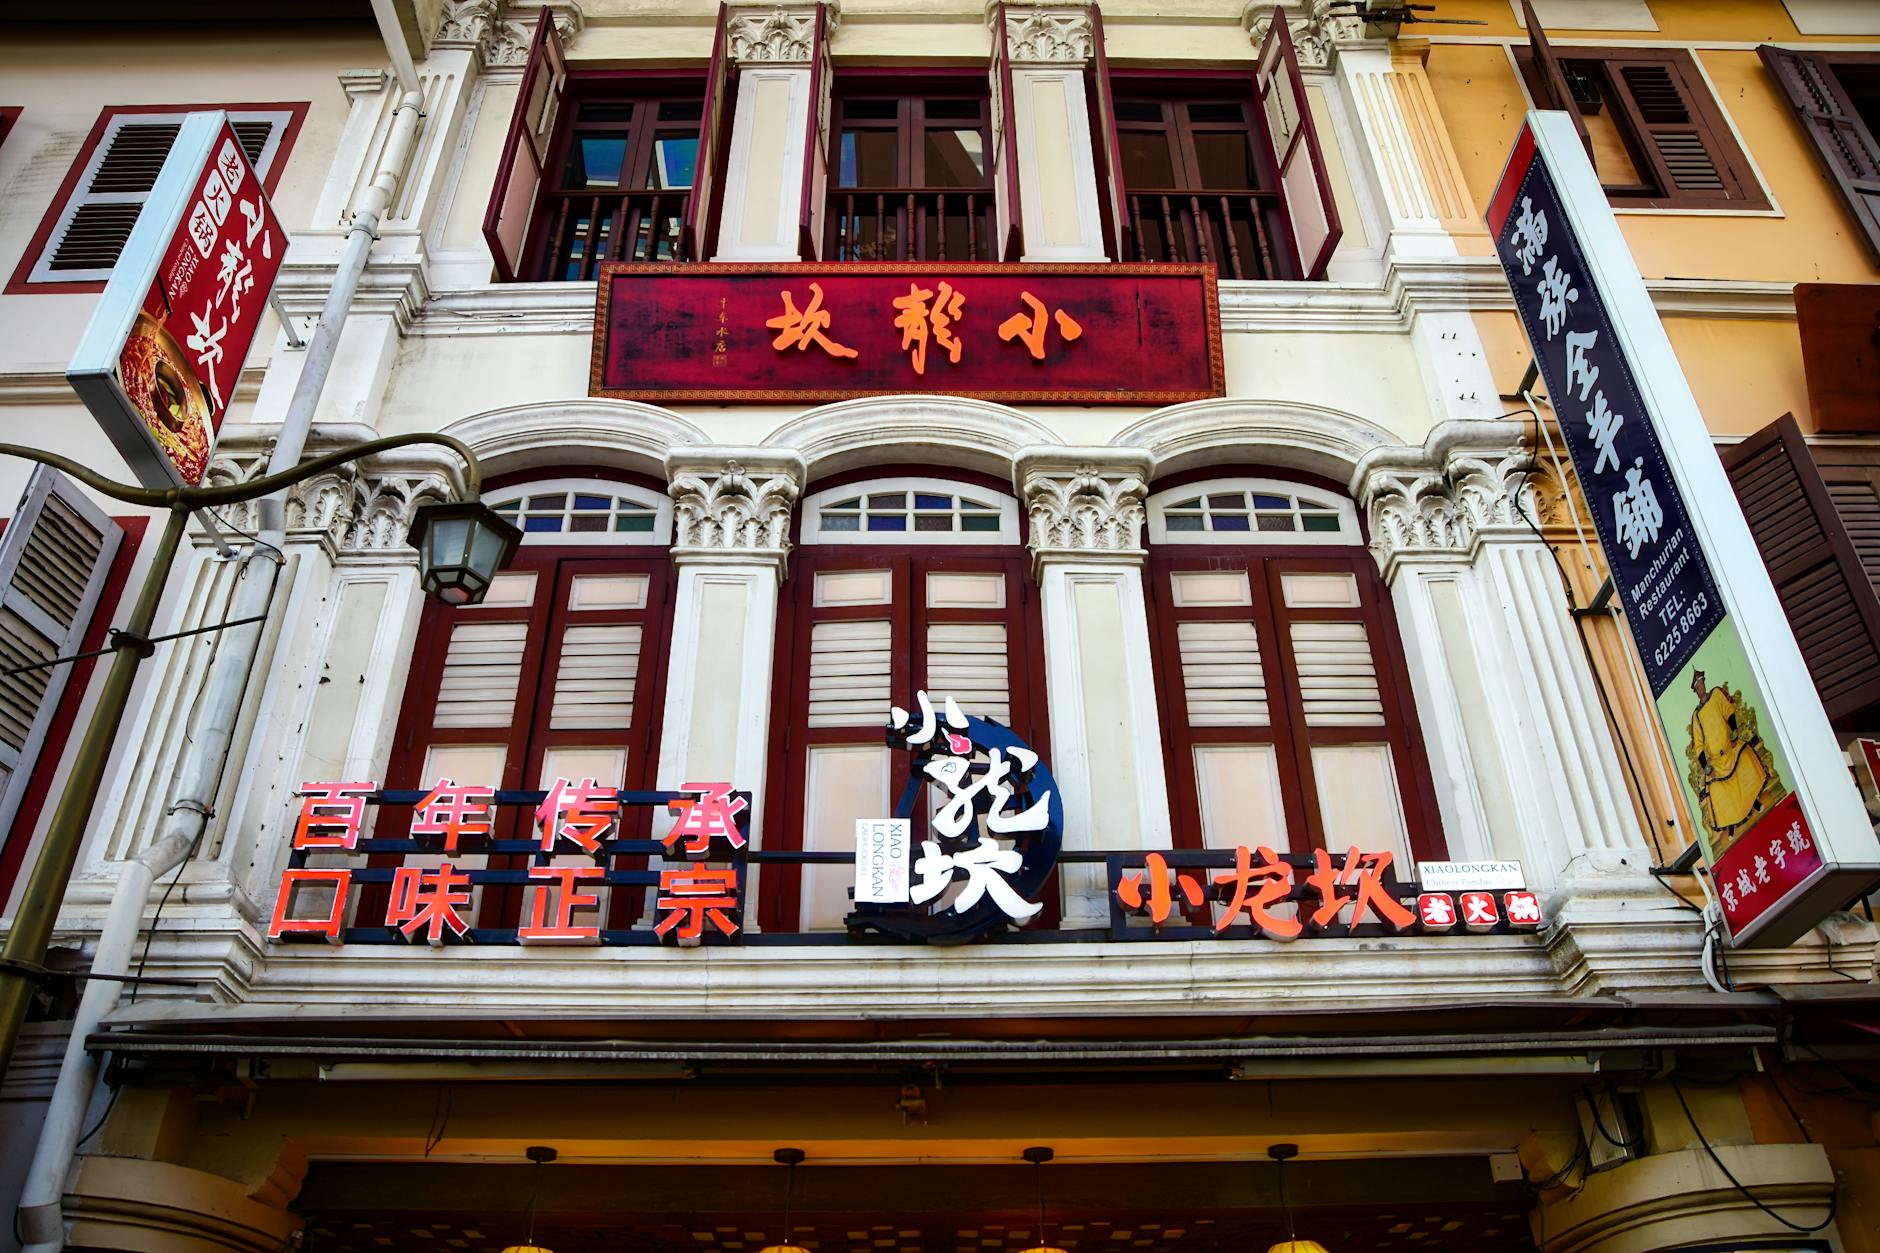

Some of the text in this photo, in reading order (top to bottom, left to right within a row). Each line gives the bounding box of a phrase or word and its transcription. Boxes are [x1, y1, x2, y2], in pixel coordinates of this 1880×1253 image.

[193, 150, 241, 254] 老火锅
[169, 245, 194, 300] LONGKAN
[185, 254, 199, 283] XIAO
[1631, 528, 1684, 603] Manchurian
[1639, 546, 1690, 620] Restaurant
[1654, 591, 1708, 666] 6225 8663
[1658, 590, 1687, 627] TEL:
[294, 777, 748, 855] 百年传承
[890, 824, 902, 859] XIAO
[872, 823, 885, 897] LONGKAN
[1117, 845, 1417, 940] 小龙坎
[1423, 863, 1518, 874] XIAOLONGKAN
[267, 862, 741, 942] 口味正宗
[1421, 893, 1541, 924] 老火锅
